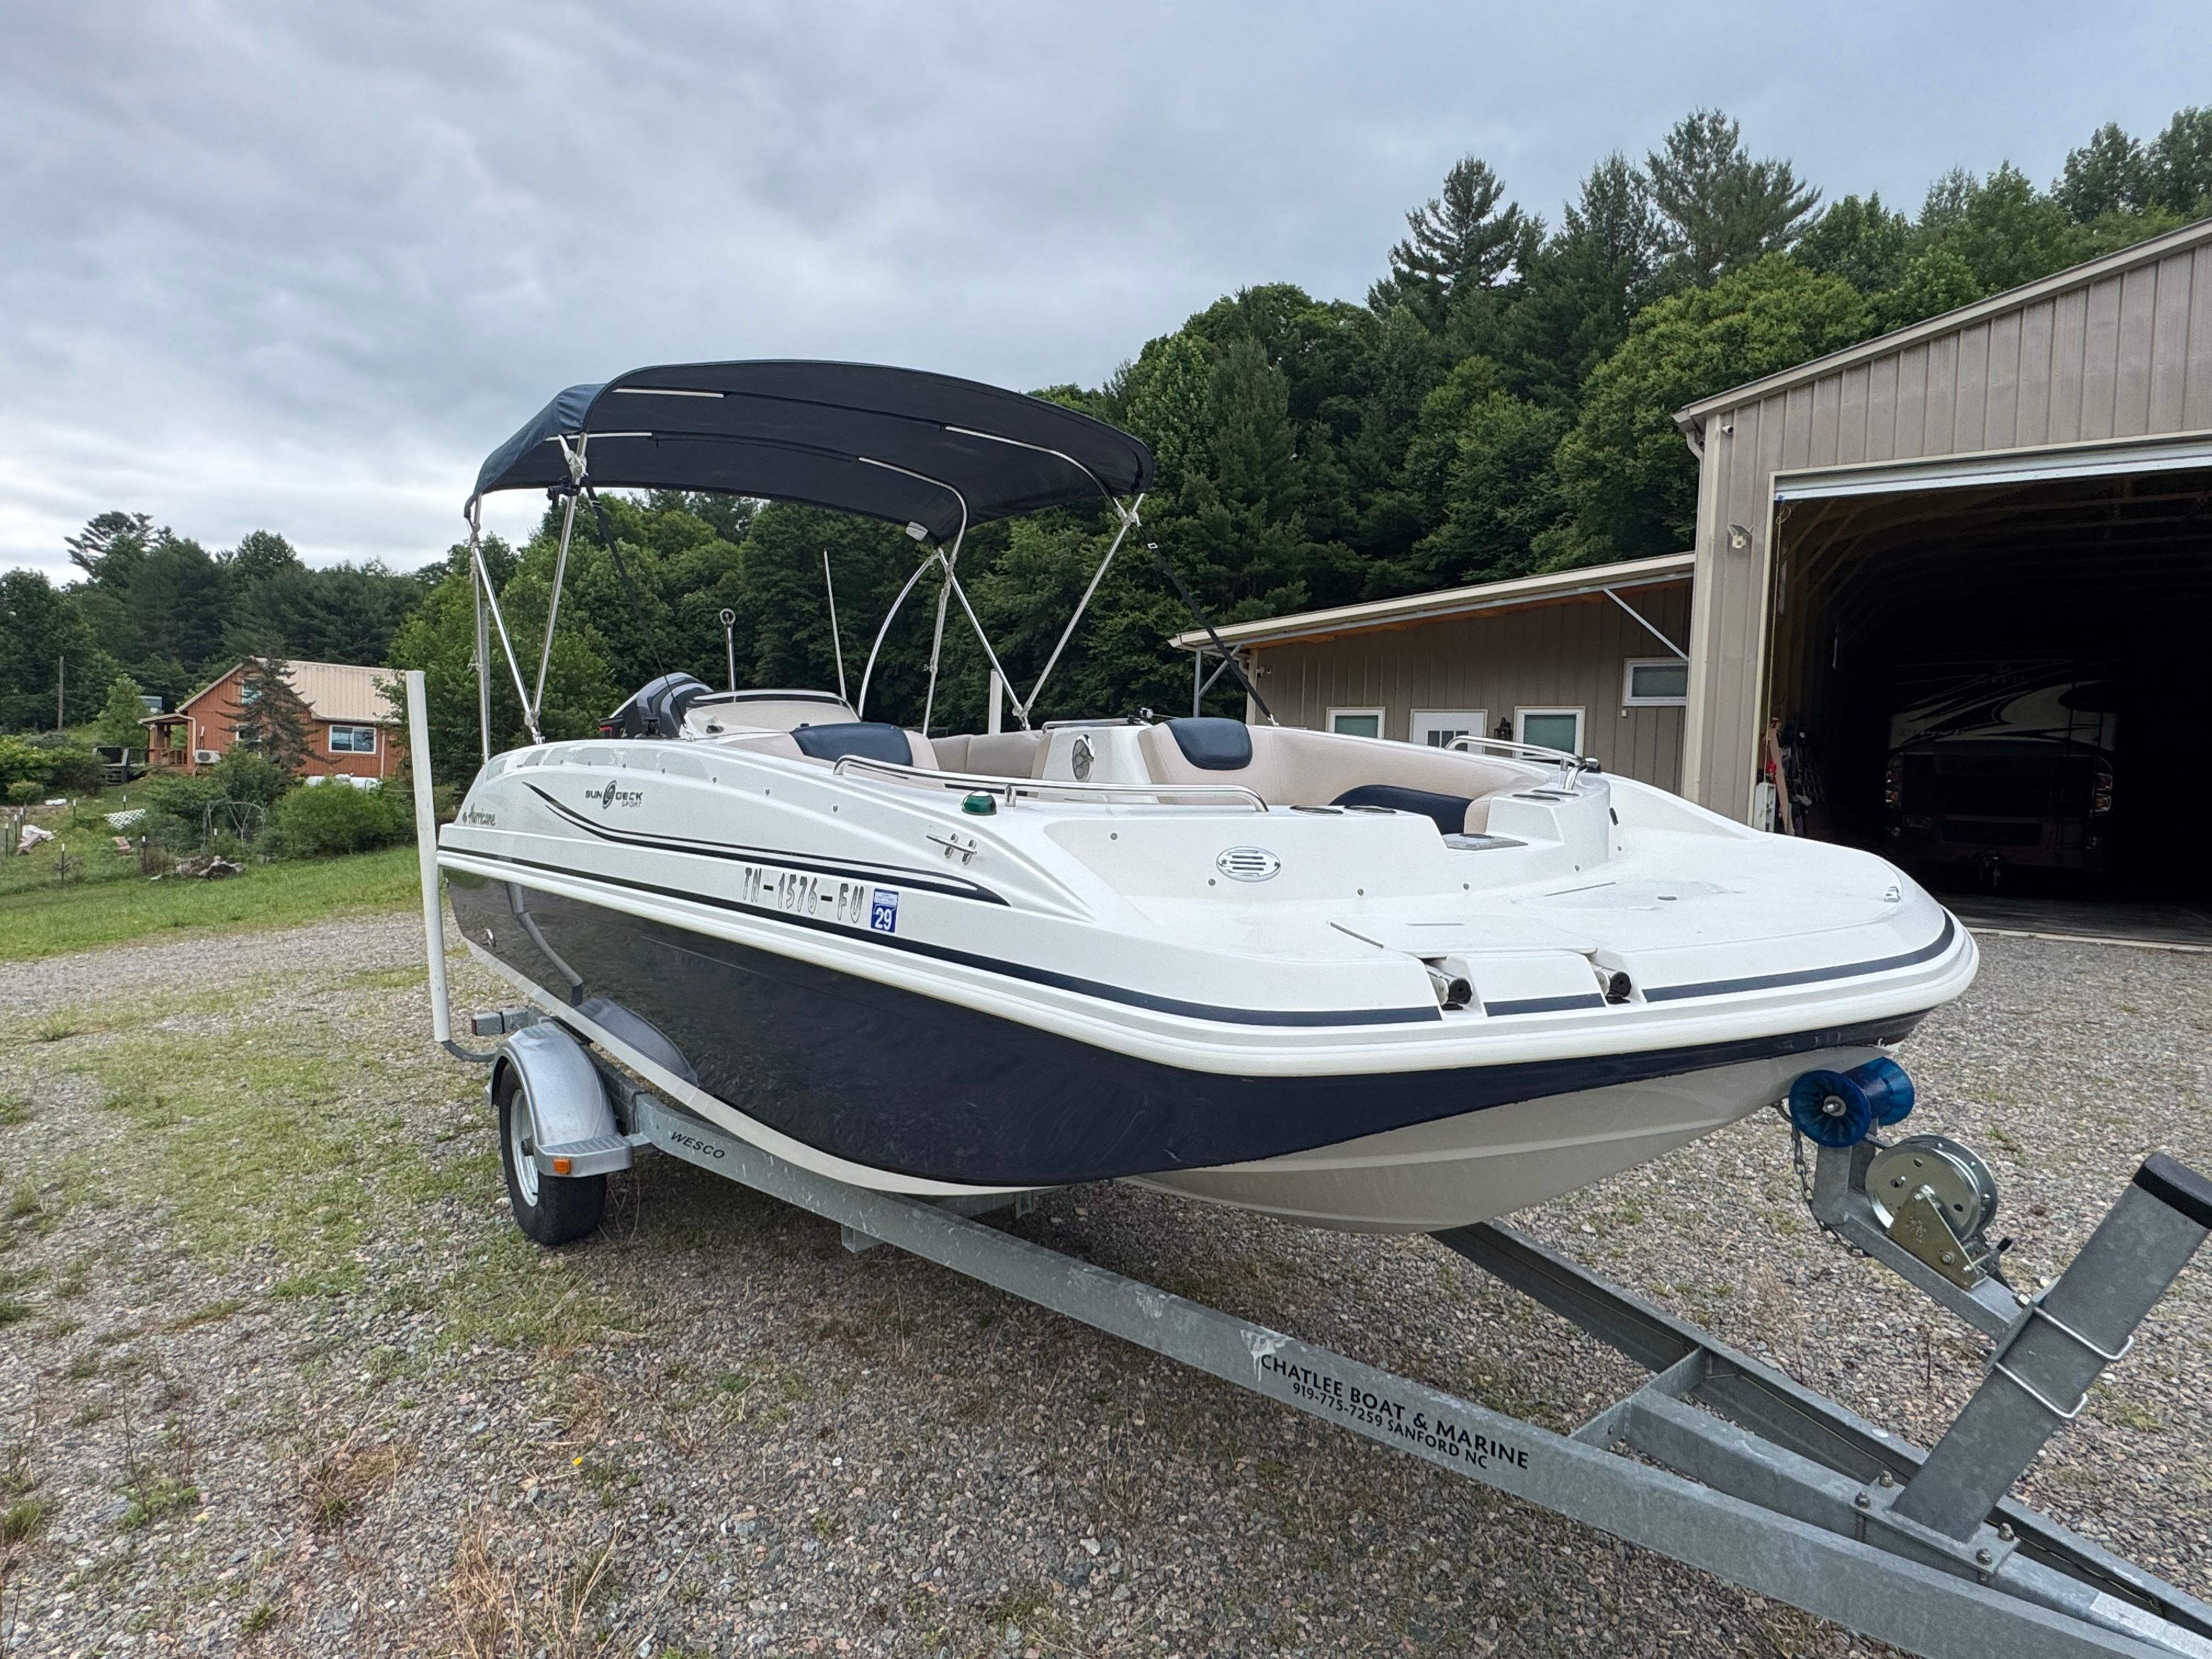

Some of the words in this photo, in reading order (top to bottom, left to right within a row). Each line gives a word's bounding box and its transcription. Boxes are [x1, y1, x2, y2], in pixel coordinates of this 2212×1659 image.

[585, 790, 602, 799] SUN
[616, 792, 644, 801] DECK
[874, 907, 892, 930] 29
[671, 1131, 725, 1159] WESCO
[1261, 1355, 1343, 1398] CHATLEE
[1350, 1386, 1406, 1420] BOAT
[1413, 1413, 1427, 1431] &
[1436, 1420, 1530, 1470] MARINE
[1293, 1383, 1383, 1427] 919-775-7259
[1387, 1420, 1459, 1457] SANFORD
[1465, 1449, 1488, 1470] NC
